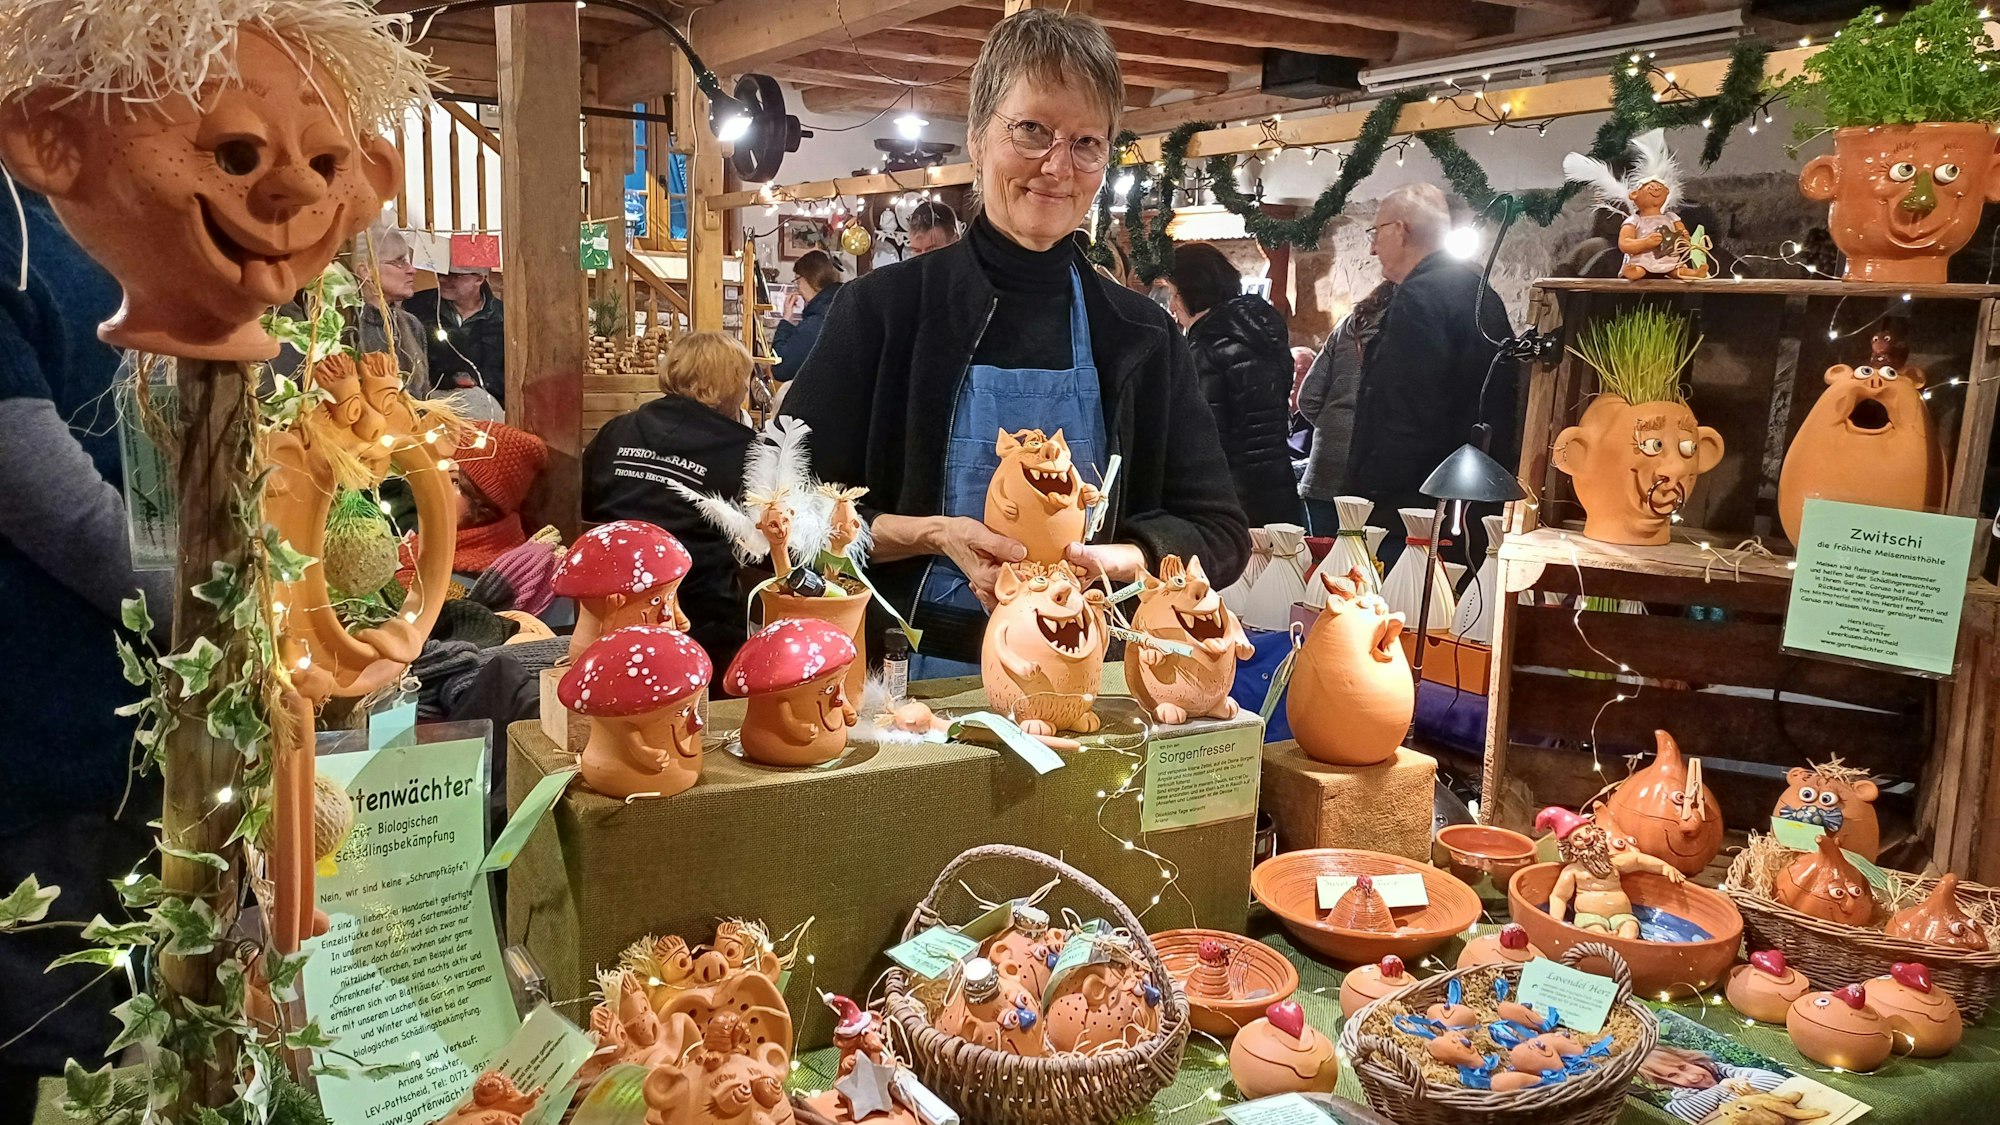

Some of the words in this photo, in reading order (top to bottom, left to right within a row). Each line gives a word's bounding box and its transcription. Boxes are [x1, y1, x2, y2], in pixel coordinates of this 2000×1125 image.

[615, 469, 645, 478] THOMAS
[645, 473, 668, 483] HECK
[1851, 528, 1923, 549] Zwitschi
[1834, 543, 1871, 555] fröhliche
[1875, 550, 1946, 565] Meisennisthöhle
[1823, 569, 1843, 577] helfen
[1870, 576, 1941, 593] Schädlingsvernichtung
[1854, 566, 1880, 575] fleissige
[1882, 570, 1936, 583] Insektensammler
[1812, 590, 1850, 600] Nistmaterial
[1852, 596, 1870, 604] sollte
[1882, 601, 1903, 609] Herbst
[1906, 605, 1934, 614] entfernt
[1818, 584, 1848, 593] Rückseite
[1866, 591, 1925, 606] Reinigungsöffnung.
[1836, 601, 1859, 610] heissem
[1887, 610, 1916, 619] gereinigt
[1919, 615, 1944, 624] werden.
[1827, 630, 1898, 646] Leverkusen-Pattscheid
[1862, 629, 1891, 637] Schuster
[1821, 639, 1898, 656] www.gartenwächter.com
[1160, 742, 1236, 764] Sorgenfresser
[378, 815, 438, 835] Biologischen
[320, 894, 342, 904] Nein,
[346, 888, 358, 898] wir
[363, 882, 378, 895] sind
[382, 878, 402, 889] keine
[338, 920, 351, 930] sind
[363, 908, 399, 923] liebeer
[402, 896, 438, 915] Handarbeit
[440, 889, 473, 906] gefertigte
[321, 931, 369, 949] Einzelstücke
[371, 926, 383, 936] der
[386, 918, 415, 930] Gung
[332, 951, 340, 961] In
[342, 943, 373, 958] unserem
[375, 936, 392, 949] Kopf
[425, 925, 438, 934] sich
[440, 921, 455, 930] zwar
[458, 916, 469, 925] nur
[330, 959, 369, 976] Holzwolle,
[371, 951, 388, 964] doch
[410, 939, 435, 952] wohnen
[438, 934, 452, 944] sehr
[455, 929, 473, 941] gerne
[340, 971, 376, 987] nützliche
[378, 960, 411, 976] Tierchen,
[413, 955, 427, 965] zum
[430, 947, 454, 961] Beispiel
[456, 942, 468, 952] der
[391, 974, 410, 986] Diese
[412, 968, 425, 979] sind
[428, 962, 450, 974] nachts
[452, 956, 468, 966] aktiv
[470, 951, 482, 960] und
[330, 1004, 370, 1021] ernähren
[367, 998, 382, 1009] sich
[385, 993, 397, 1003] von
[443, 974, 452, 982] So
[454, 964, 486, 981] verzieren
[1546, 971, 1588, 990] Lavendel
[1588, 984, 1612, 997] Herz
[327, 1026, 339, 1035] wir
[343, 1021, 355, 1032] mit
[358, 1010, 389, 1026] unserem
[391, 1001, 416, 1015] Lachen
[418, 996, 429, 1006] die
[457, 984, 465, 992] im
[467, 975, 493, 990] Sommer
[361, 1030, 375, 1040] und
[377, 1018, 403, 1035] Winter
[406, 1014, 419, 1024] und
[420, 1005, 443, 1019] helfen
[445, 1001, 456, 1011] bei
[458, 996, 470, 1006] der
[353, 1035, 399, 1058] biologischen
[401, 1007, 481, 1040] Schädlingsbekämpfung.
[425, 1052, 440, 1062] und
[443, 1035, 478, 1053] Verkauf:
[398, 1074, 424, 1089] Ariane
[426, 1058, 463, 1077] Schuster,
[365, 1088, 431, 1119] LEV-Pattscheid,
[432, 1079, 447, 1091] Tel:
[450, 1070, 468, 1083] 0172
[379, 1085, 470, 1125] ww.gartenwächt
